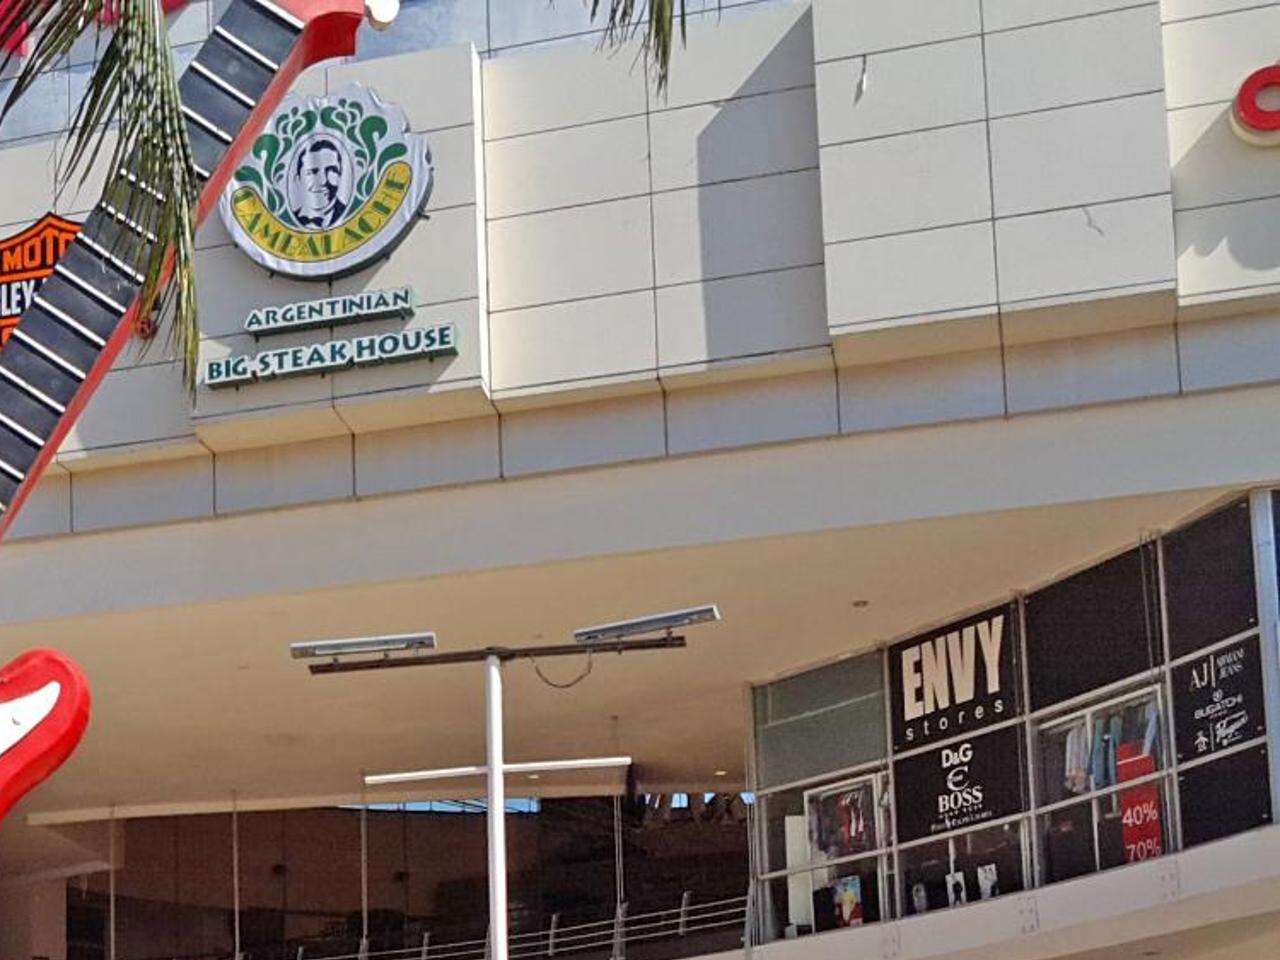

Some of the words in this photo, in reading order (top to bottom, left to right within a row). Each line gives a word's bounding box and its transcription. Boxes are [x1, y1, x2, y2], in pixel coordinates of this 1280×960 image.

[247, 288, 410, 328] ARGENTINIAN
[207, 356, 248, 380] BIG
[258, 342, 347, 372] STEAK
[356, 325, 452, 359] HOUSE
[902, 614, 1004, 722] ENVY
[905, 699, 1003, 741] stores
[941, 743, 974, 768] D&G
[938, 785, 984, 813] BOSS
[1122, 801, 1158, 828] 40%
[1126, 837, 1162, 860] 70%
